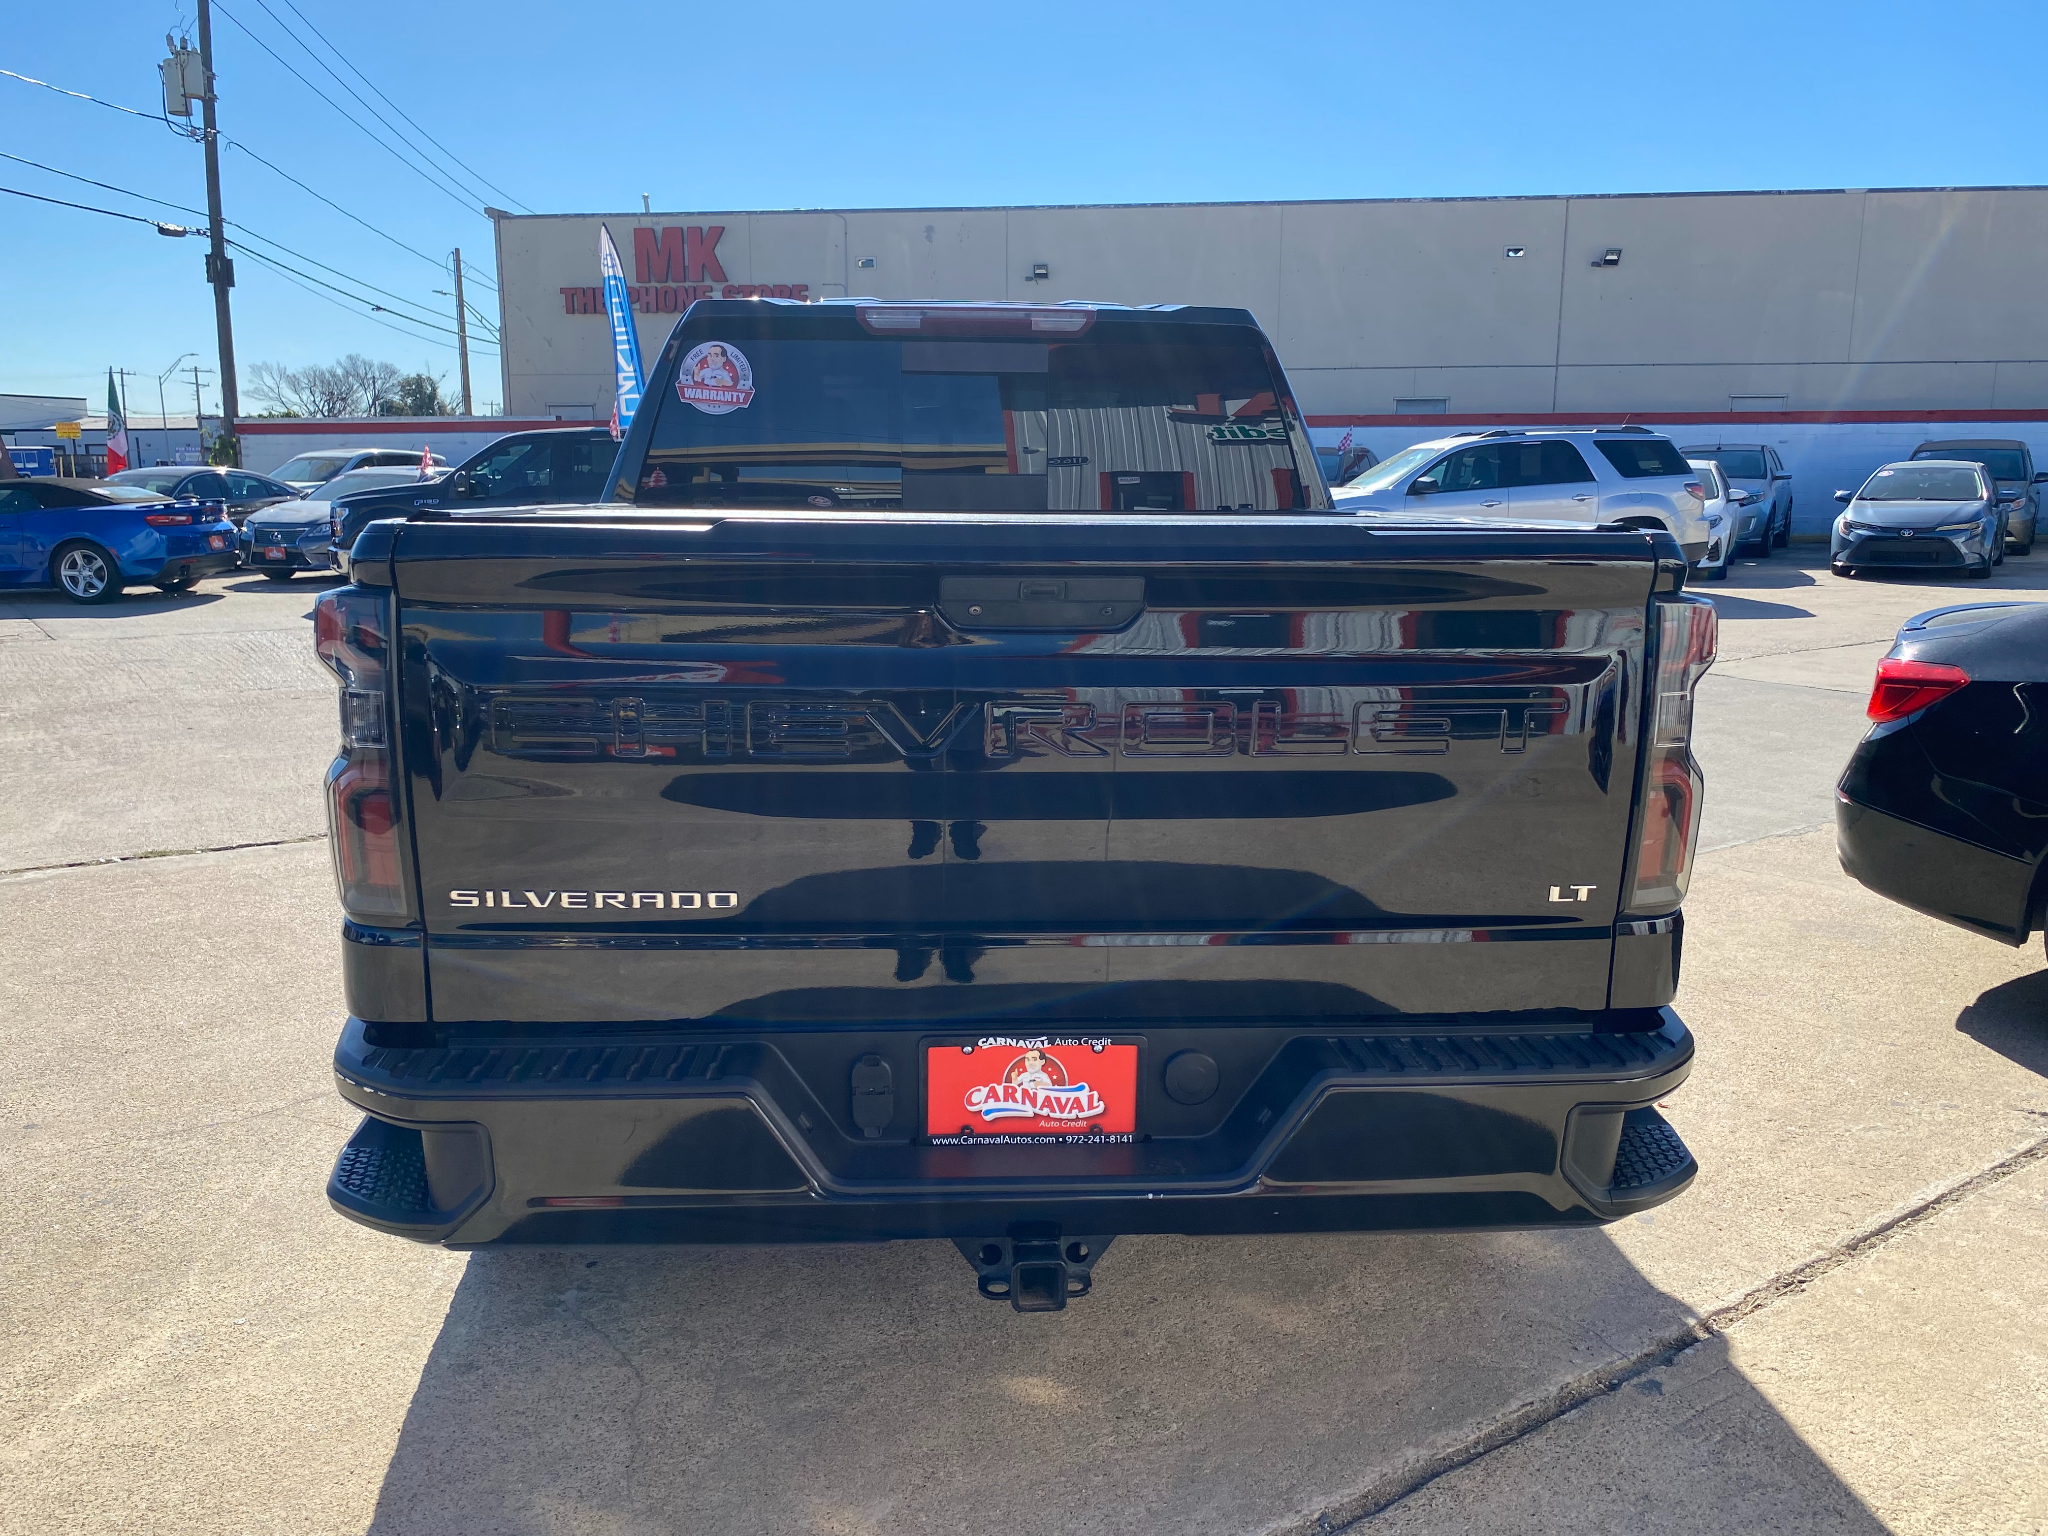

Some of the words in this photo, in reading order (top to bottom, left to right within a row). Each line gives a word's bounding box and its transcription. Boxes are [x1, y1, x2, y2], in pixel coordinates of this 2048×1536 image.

[633, 226, 728, 283] MK
[690, 348, 705, 362] FREE
[730, 351, 748, 373] LIMITED
[683, 387, 746, 403] WARRANTY
[488, 696, 1570, 757] CHEVROLET
[449, 888, 739, 910] SILVERADO
[1548, 885, 1597, 902] LT
[977, 1036, 1052, 1049] CARNAVAL
[1055, 1037, 1079, 1047] Auto
[1081, 1037, 1112, 1047] Credit
[965, 1084, 1101, 1115] CARNAVAL
[1039, 1119, 1060, 1128] Auto
[1061, 1119, 1088, 1128] Credit
[932, 1135, 1056, 1146] www.CarnavalAutos.com
[1066, 1135, 1133, 1145] 972-241-8141
